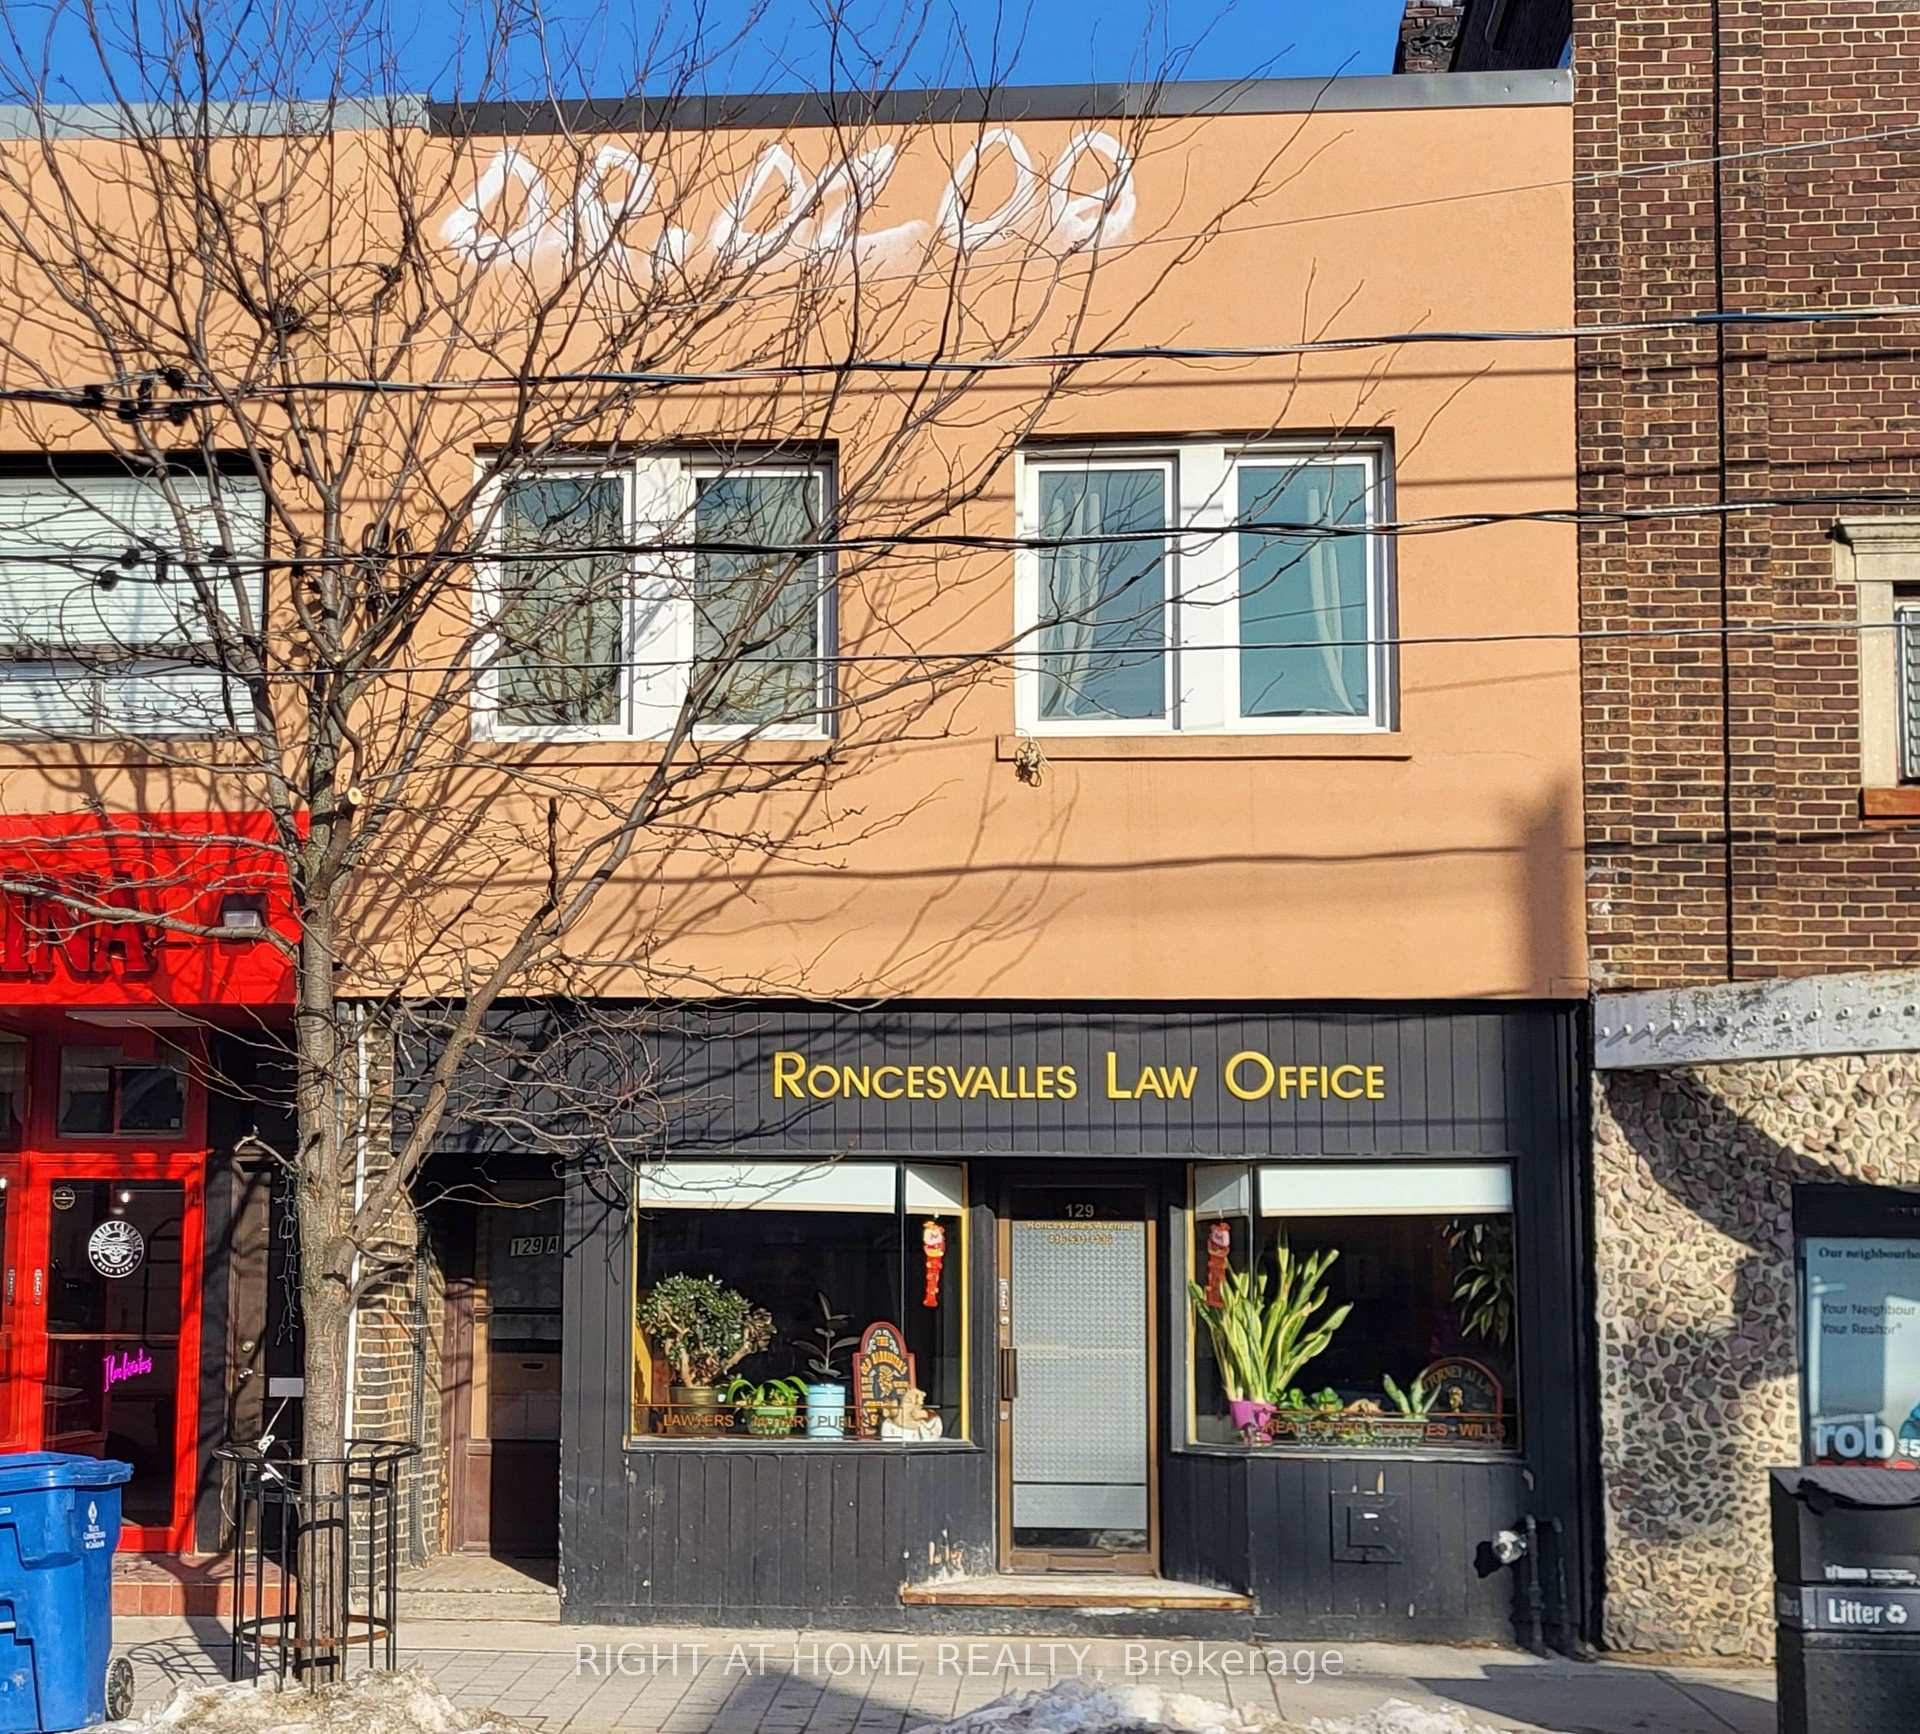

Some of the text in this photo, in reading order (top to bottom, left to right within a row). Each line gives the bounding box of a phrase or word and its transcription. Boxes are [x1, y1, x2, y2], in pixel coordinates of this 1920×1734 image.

[773, 1050, 1385, 1101] RONCESVALLES LAW OFFICE
[1065, 1203, 1095, 1218] 129
[1819, 1246, 1843, 1259] Our
[1821, 1304, 1916, 1318] Your Neighbour
[663, 1413, 735, 1428] LAWYERS
[1815, 1413, 1896, 1459] rob
[1827, 1598, 1884, 1625] Litter
